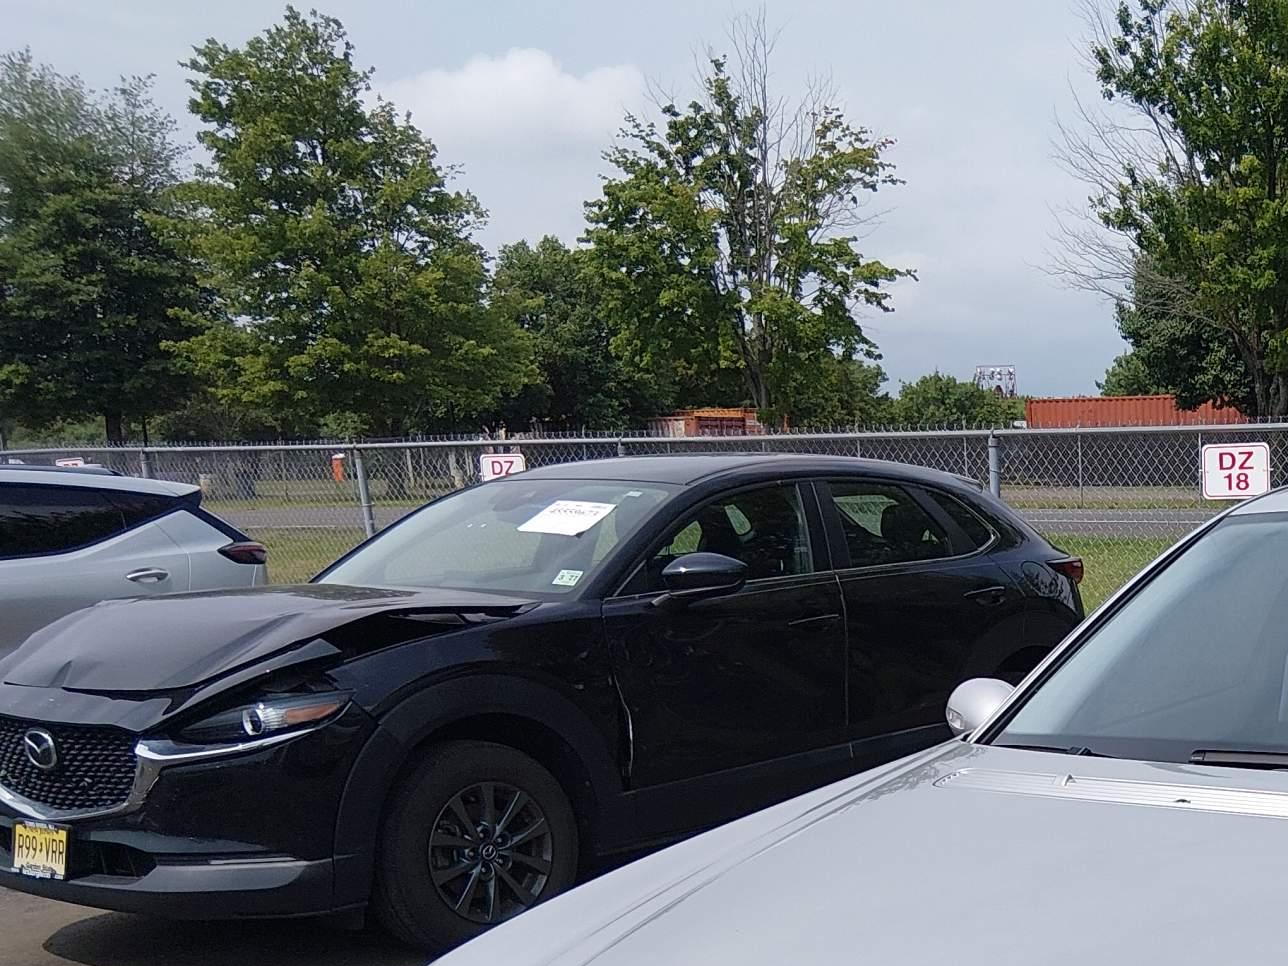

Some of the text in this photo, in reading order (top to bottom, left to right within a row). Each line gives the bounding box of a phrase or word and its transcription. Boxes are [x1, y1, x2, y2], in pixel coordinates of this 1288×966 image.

[491, 460, 514, 477] DZ
[1218, 451, 1254, 470] DZ
[1223, 472, 1250, 491] 18
